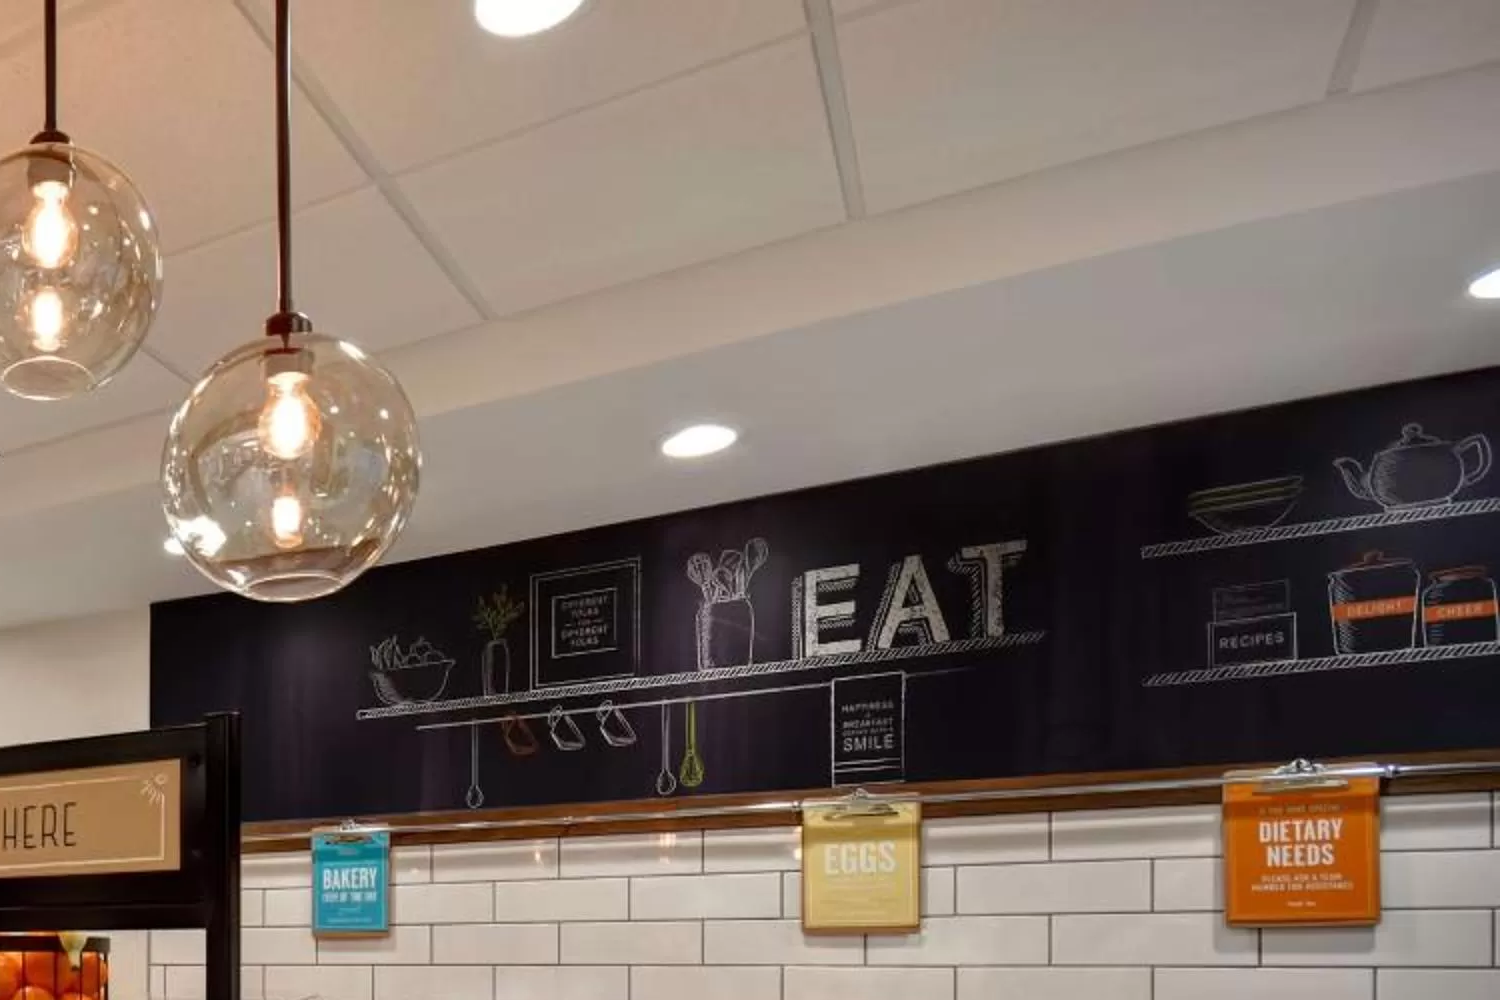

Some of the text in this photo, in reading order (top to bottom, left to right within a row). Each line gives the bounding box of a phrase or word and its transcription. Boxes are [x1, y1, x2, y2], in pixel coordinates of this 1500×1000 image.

[792, 540, 1028, 659] EAT
[1347, 601, 1402, 617] DELIGHT
[1436, 604, 1483, 619] CHEER
[1219, 631, 1284, 648] RECIPES
[843, 734, 894, 752] SMILE
[1, 801, 78, 851] HERE
[1259, 817, 1343, 843] DIETARY
[823, 840, 898, 875] EGGS
[1267, 843, 1335, 867] NEEDS
[323, 867, 378, 890] BAKERY
